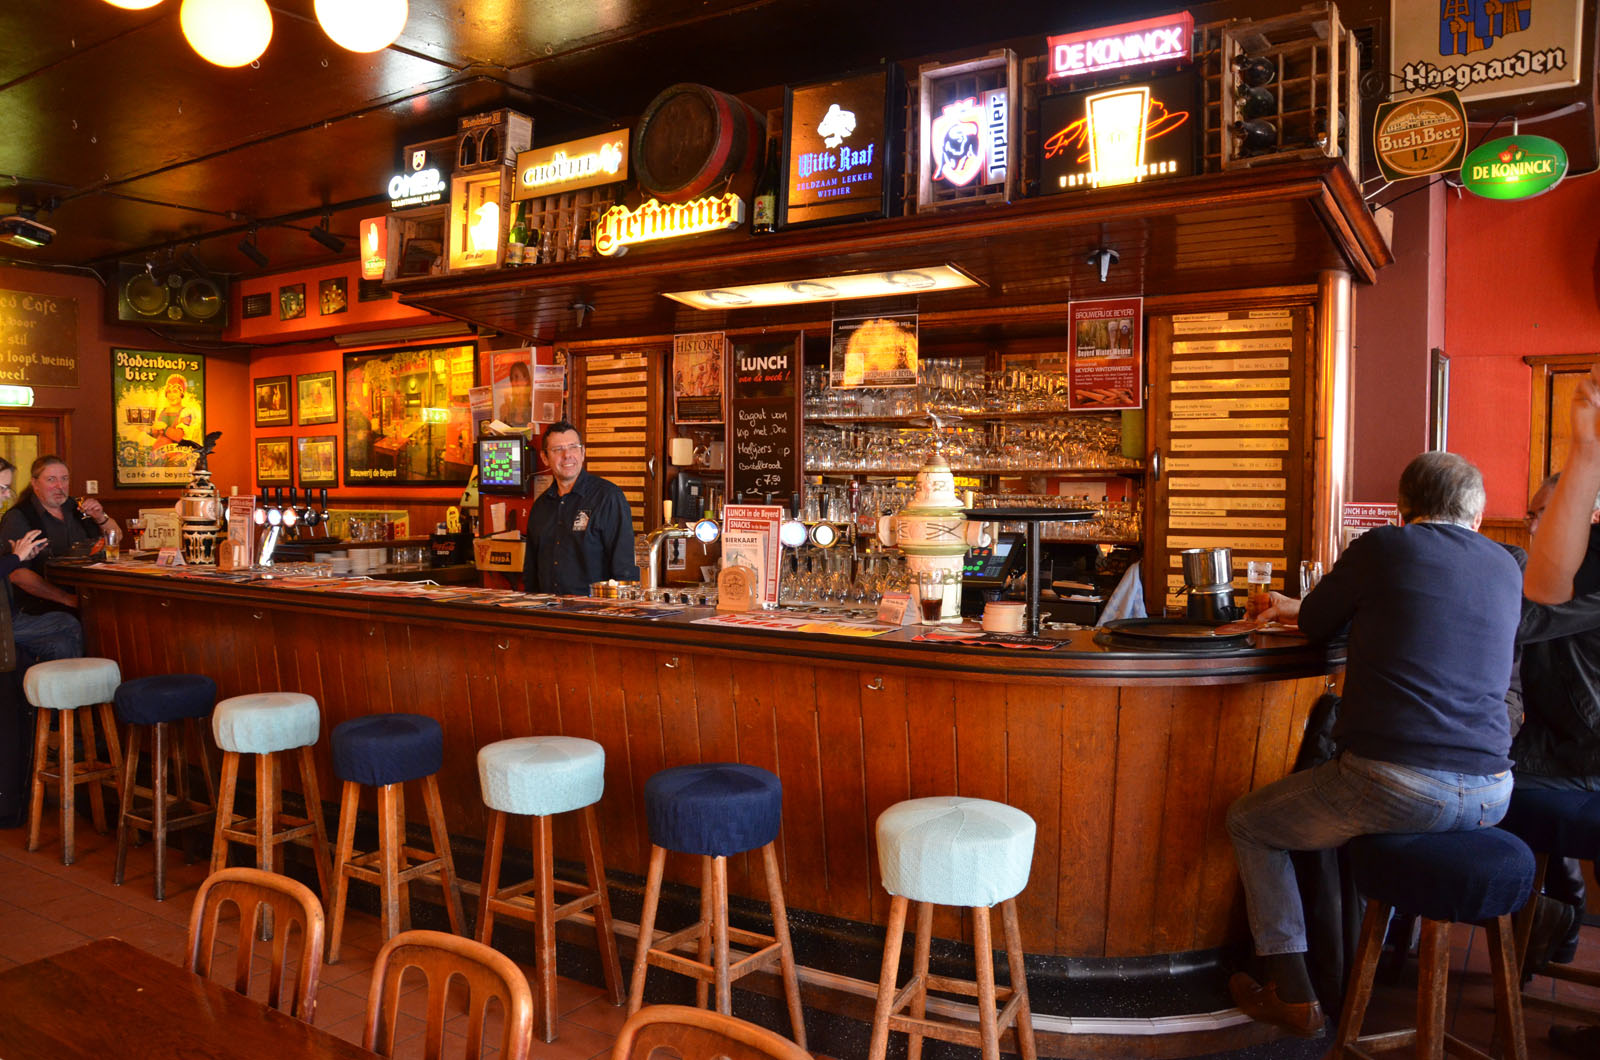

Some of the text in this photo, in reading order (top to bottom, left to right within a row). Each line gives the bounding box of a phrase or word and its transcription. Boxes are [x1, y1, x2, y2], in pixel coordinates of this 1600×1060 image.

[1055, 27, 1182, 71] DE KONINCK
[1402, 48, 1566, 93] Hoegaarden
[1380, 126, 1461, 152] Bush Beer
[798, 143, 874, 178] Witte Raaf
[1473, 159, 1551, 180] DE KONINCK
[796, 172, 873, 191] ZELDZAAM LEKKER
[817, 186, 851, 198] WITBIER
[597, 194, 735, 253] Liefmans
[1075, 310, 1105, 320] BROUWERIJ
[1113, 308, 1135, 317] BEYERD
[41, 354, 76, 370] weinig
[116, 352, 200, 371] Rodenbach's
[741, 355, 788, 371] LUNCH
[125, 367, 158, 382] bier
[739, 408, 788, 428] Ragout van
[753, 425, 768, 436] met
[126, 470, 146, 479] café
[150, 470, 160, 478] de
[350, 469, 397, 479] Brouwerij de Beyerd
[727, 508, 779, 519] LUNCH in de Beyerd
[1344, 507, 1398, 517] UNCH in de Beyerd
[730, 521, 751, 529] SNACKS
